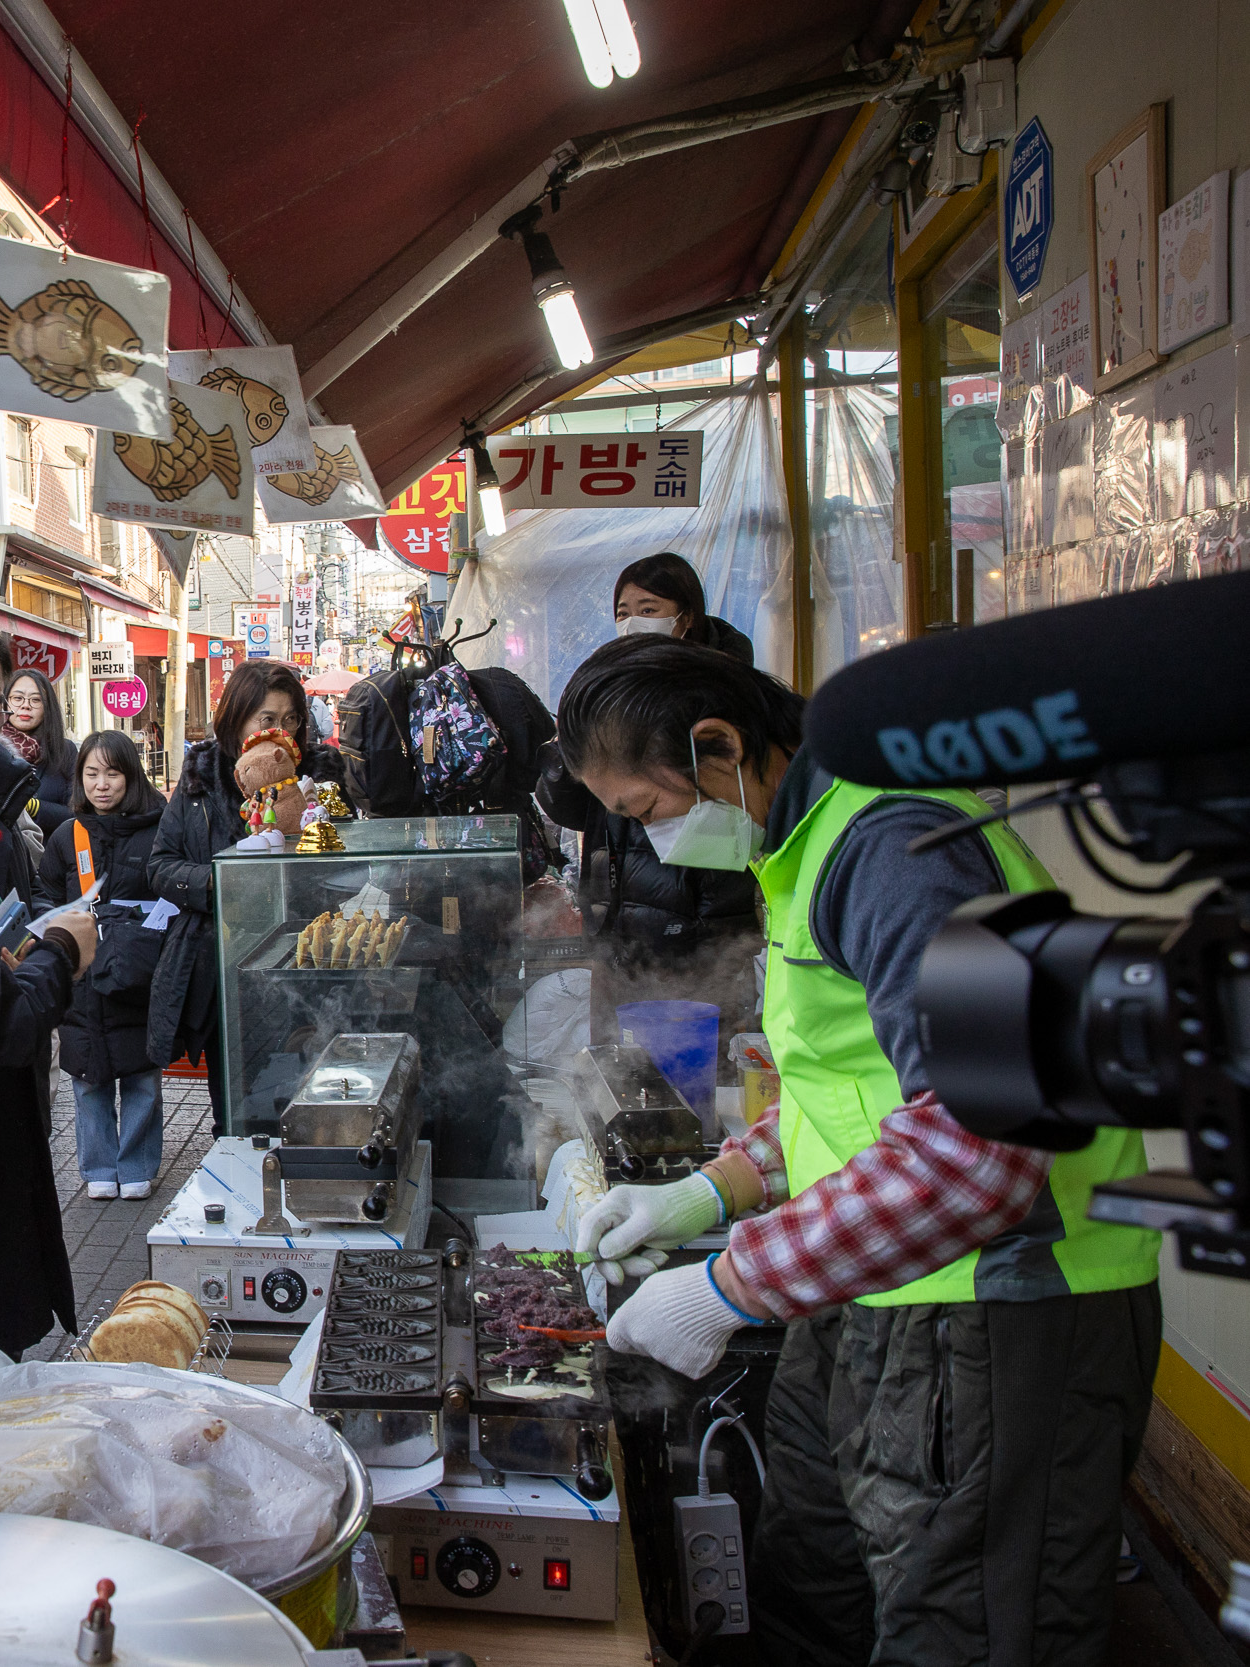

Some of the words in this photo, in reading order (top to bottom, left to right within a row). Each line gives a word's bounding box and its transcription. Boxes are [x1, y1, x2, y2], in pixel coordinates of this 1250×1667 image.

[1011, 163, 1044, 249] ADT
[1051, 291, 1081, 335] 고장난
[258, 462, 283, 473] 2마리
[286, 459, 304, 470] 천원
[498, 442, 647, 496] 가방
[295, 586, 313, 599] 족발
[294, 600, 312, 651] 뽕나무
[91, 650, 112, 661] 벽지
[92, 663, 124, 675] 바닥재
[107, 691, 141, 709] 미용실
[876, 688, 1099, 784] RØDE
[260, 1252, 314, 1261] MACHINE
[401, 1514, 426, 1523] SUN
[437, 1516, 515, 1531] MACHINE
